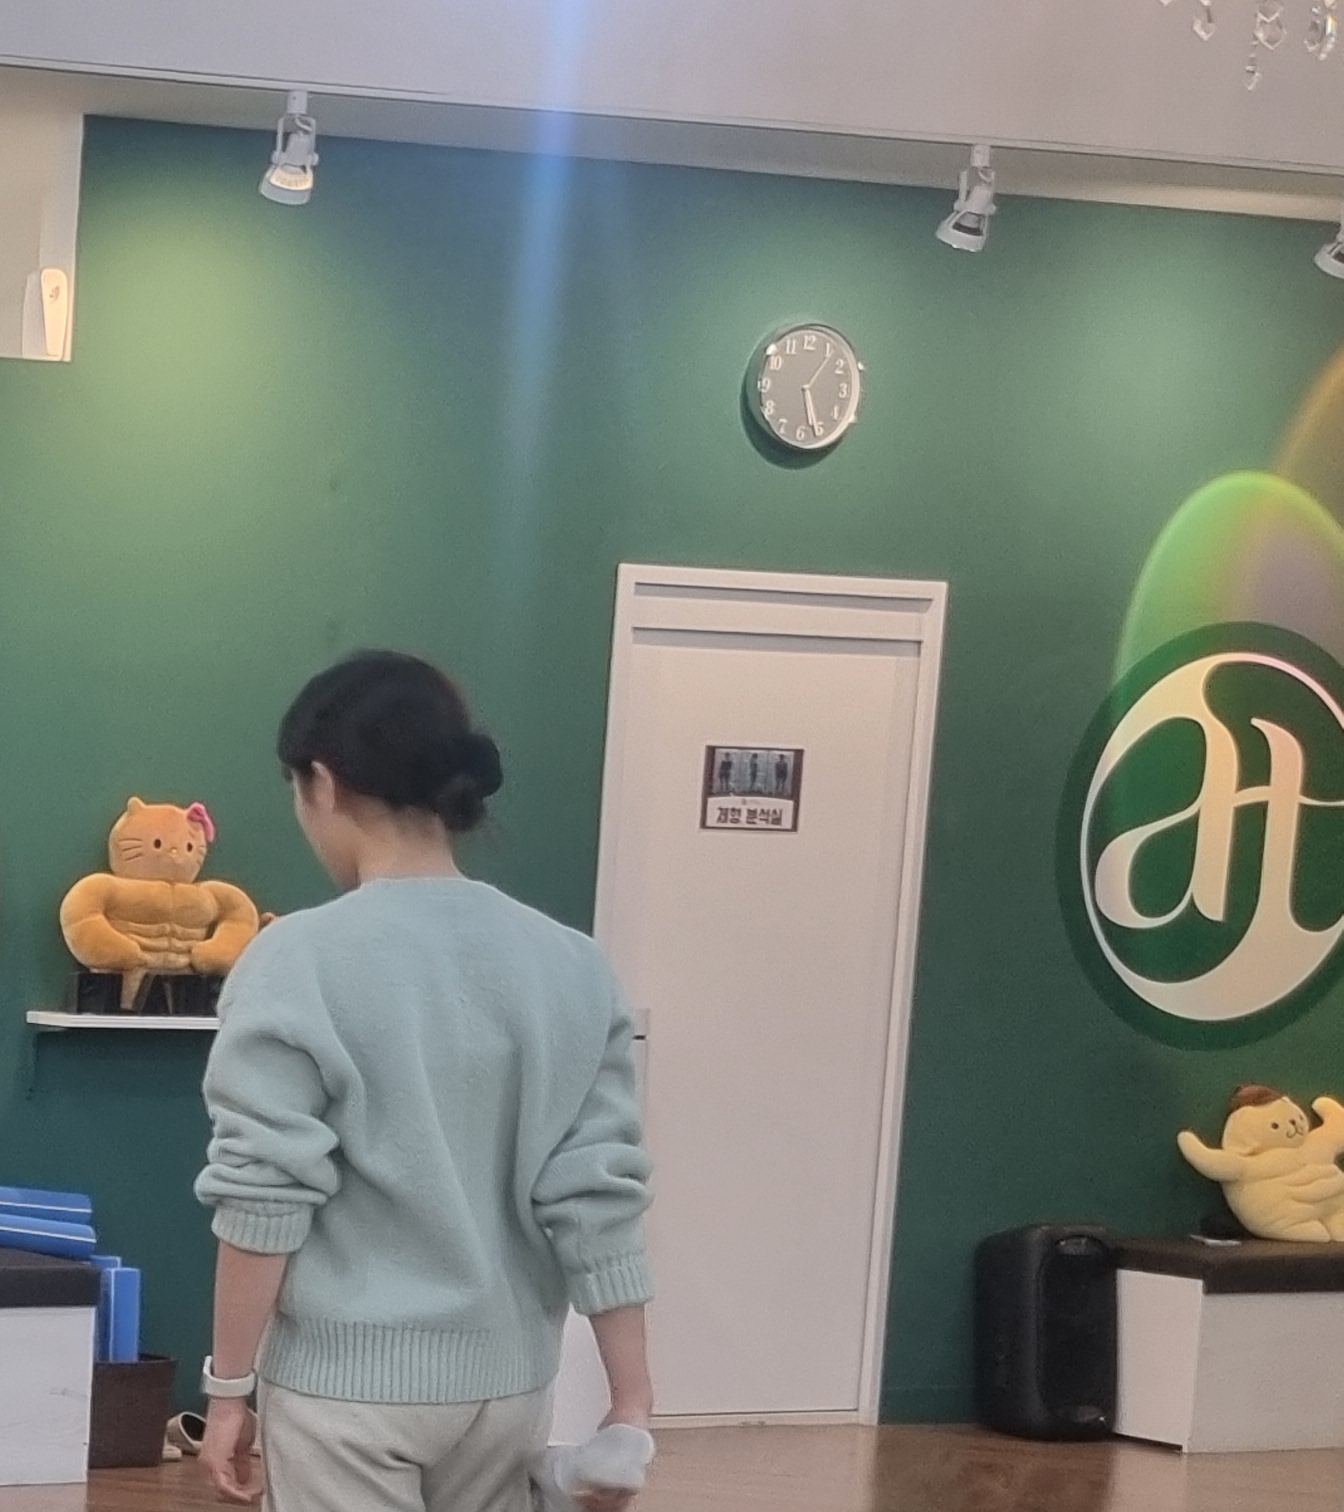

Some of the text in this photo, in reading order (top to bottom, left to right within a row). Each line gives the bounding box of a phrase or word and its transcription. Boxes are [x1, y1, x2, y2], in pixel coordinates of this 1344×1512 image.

[785, 339, 797, 355] 11
[803, 335, 817, 351] 12
[769, 355, 783, 371] 10
[834, 359, 845, 375] 2
[761, 378, 771, 393] 9
[838, 383, 848, 398] 3
[764, 400, 776, 415] 8
[778, 418, 788, 434] 7
[796, 425, 806, 440] 6
